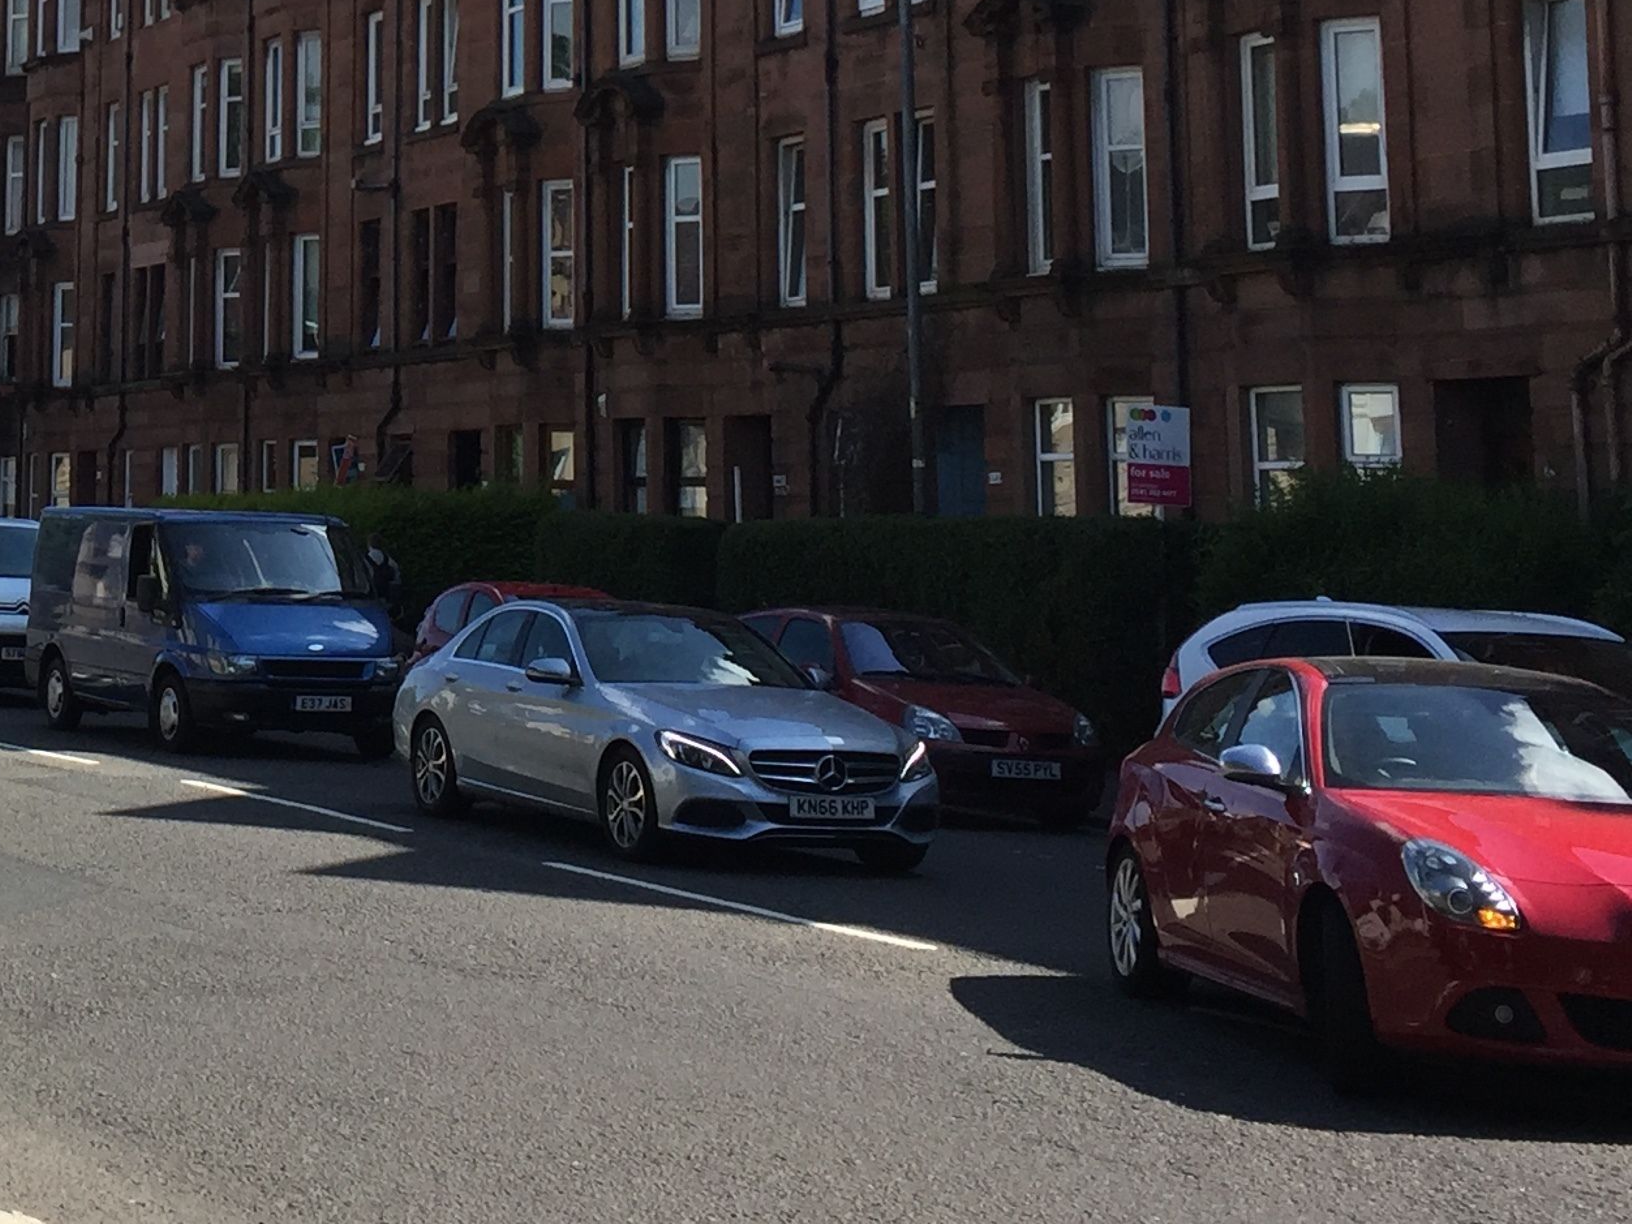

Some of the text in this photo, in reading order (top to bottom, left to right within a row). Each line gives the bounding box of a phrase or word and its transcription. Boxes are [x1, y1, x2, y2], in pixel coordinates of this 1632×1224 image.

[1128, 425, 1161, 442] allen
[1143, 444, 1184, 462] harris
[1130, 466, 1146, 477] for
[796, 798, 870, 816] KN66 KHP
